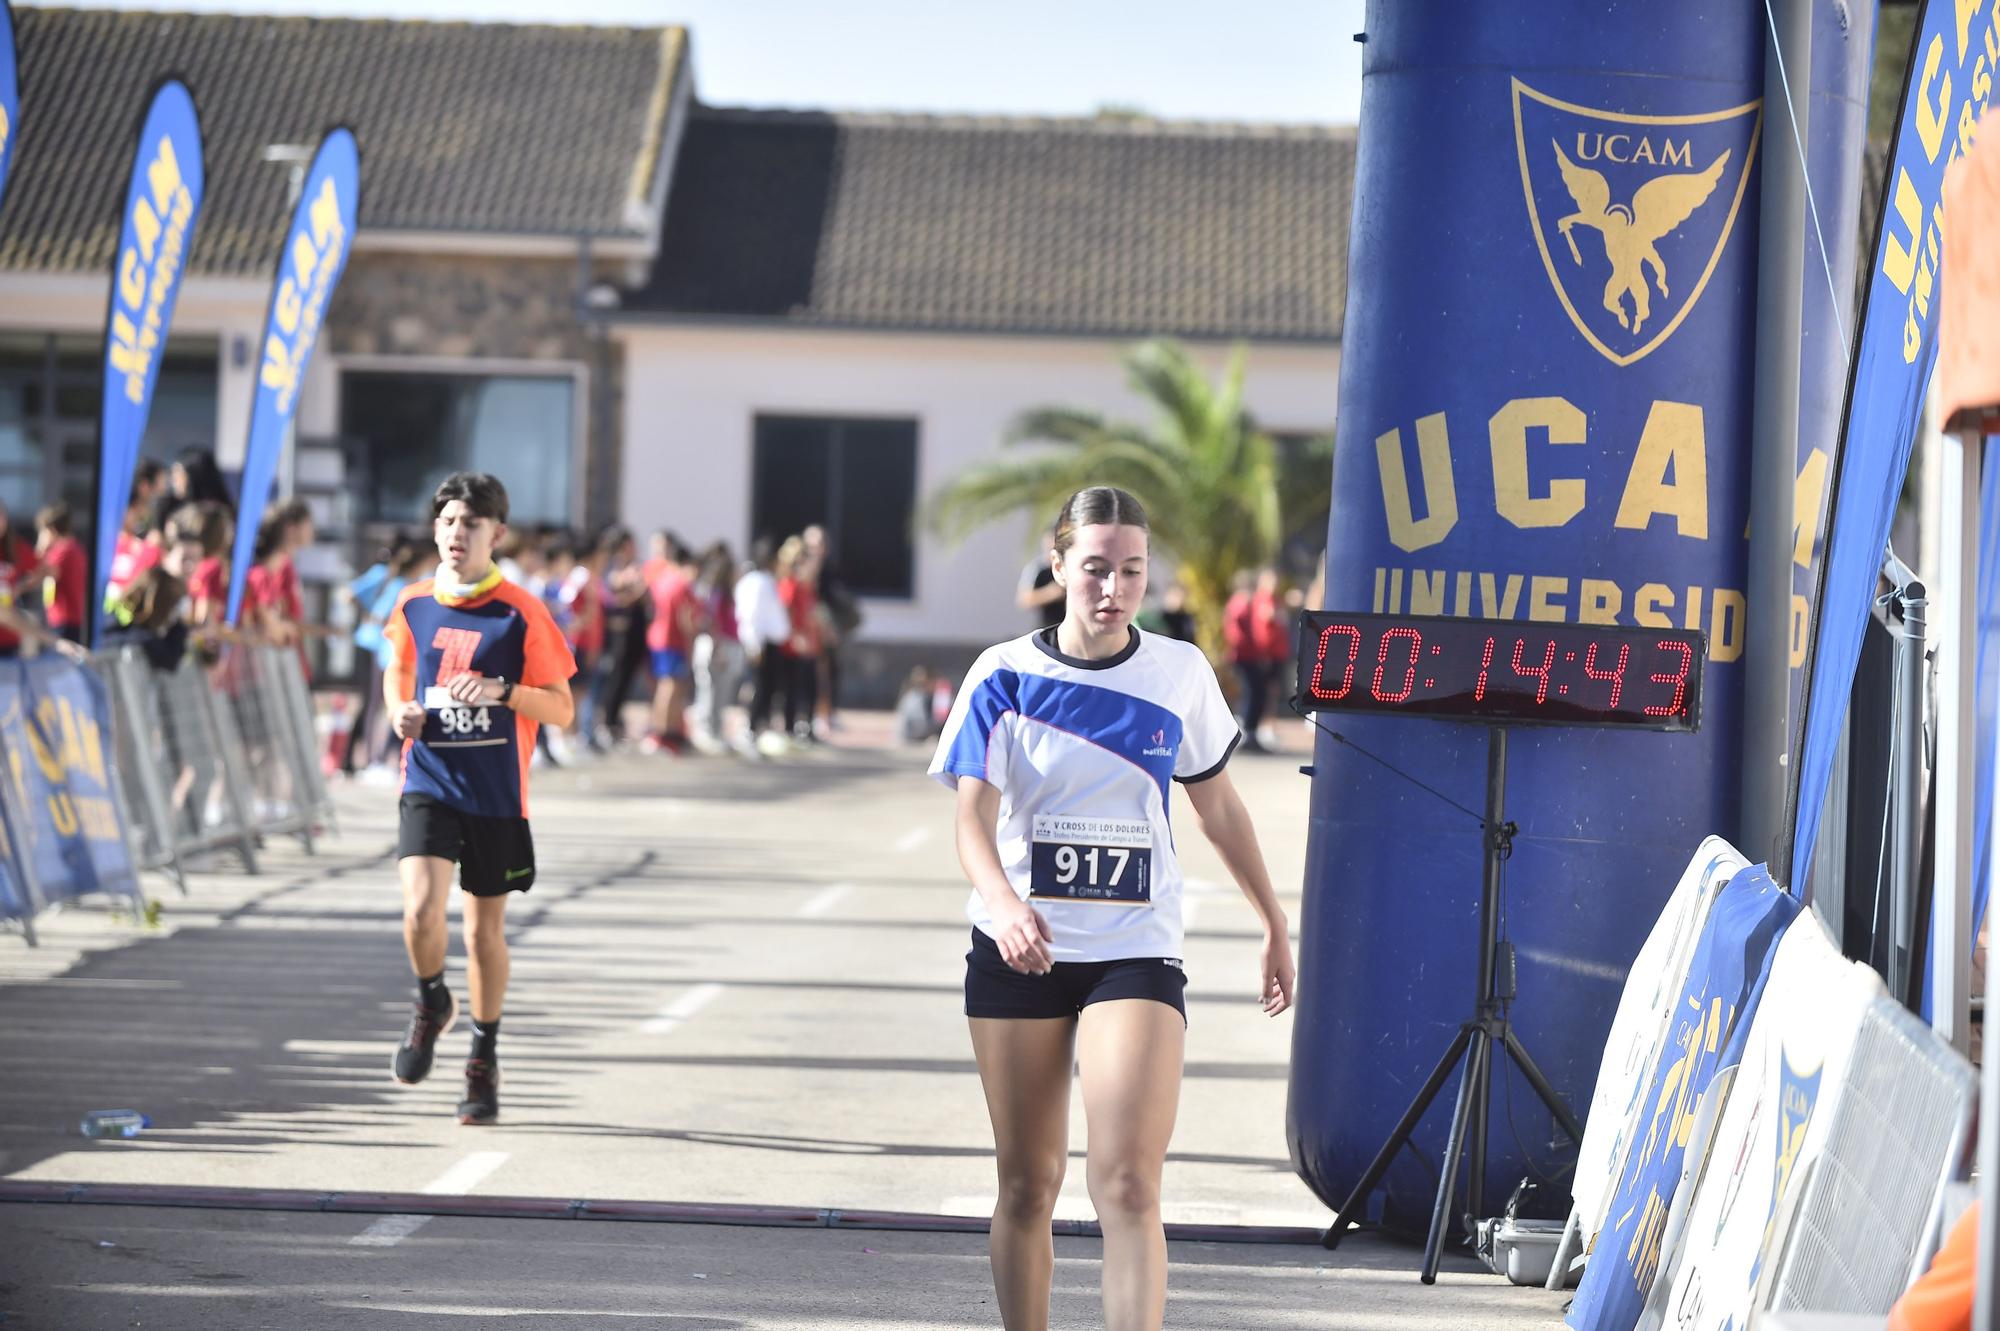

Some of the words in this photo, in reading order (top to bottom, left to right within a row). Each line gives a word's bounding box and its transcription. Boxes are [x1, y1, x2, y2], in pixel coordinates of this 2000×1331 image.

[1577, 132, 1693, 168] UCAM
[110, 133, 181, 373] UCAM
[1373, 567, 1808, 668] UNIVERSIDD
[1310, 624, 1693, 717] 00:14:43
[439, 706, 492, 734] 984
[1061, 822, 1086, 831] CROSS
[1099, 824, 1114, 832] LOS
[1116, 825, 1150, 834] DOLORES
[1055, 845, 1130, 886] 917
